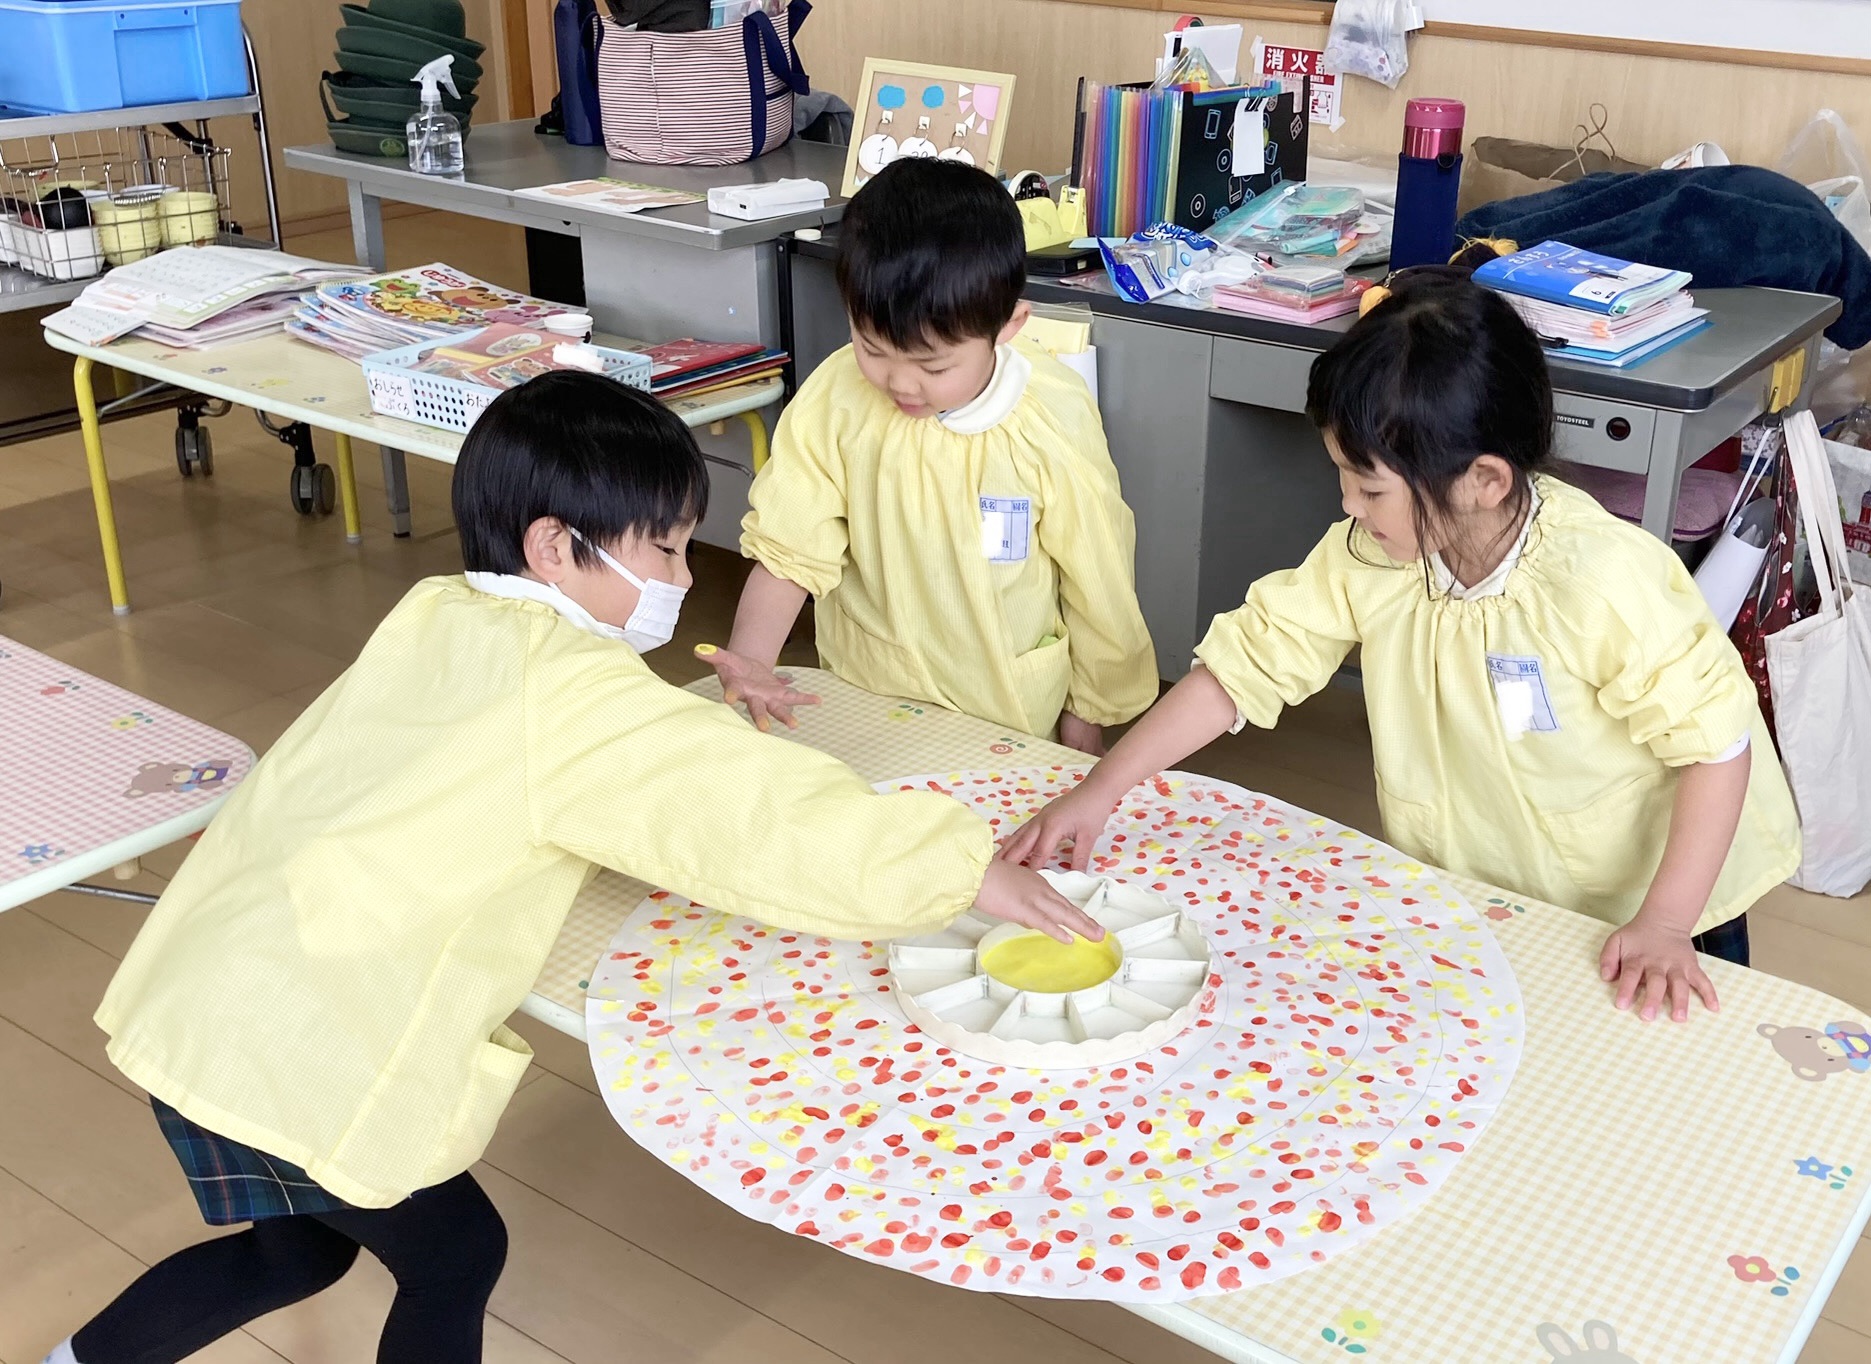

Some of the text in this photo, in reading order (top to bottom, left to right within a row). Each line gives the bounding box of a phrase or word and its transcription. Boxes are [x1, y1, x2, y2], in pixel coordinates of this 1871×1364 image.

[874, 147, 886, 165] 1
[374, 377, 404, 397] おしらせ
[1556, 415, 1589, 426] TOYOSTEEL
